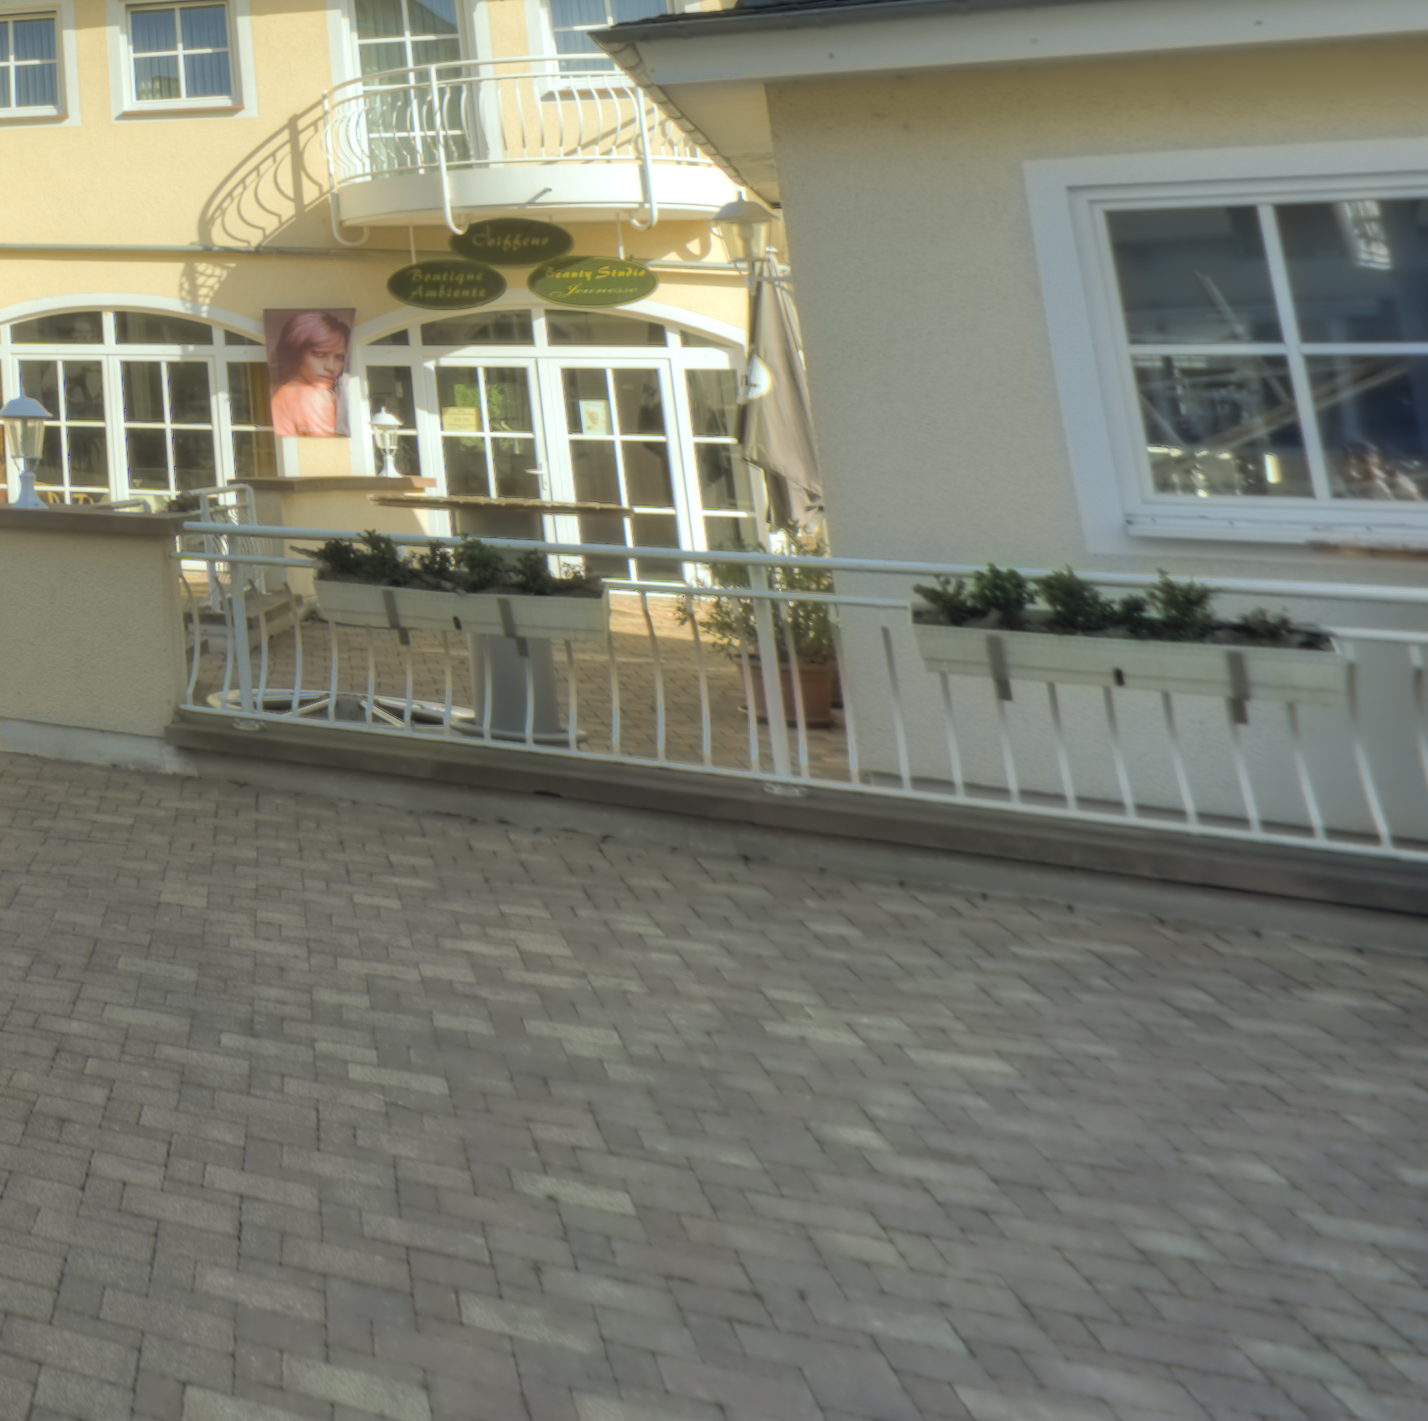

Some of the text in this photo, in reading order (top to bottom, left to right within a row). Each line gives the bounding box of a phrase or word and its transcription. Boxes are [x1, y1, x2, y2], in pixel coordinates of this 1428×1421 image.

[472, 233, 550, 251] Coiffeur
[408, 268, 484, 285] Boutique
[546, 265, 646, 281] Beauty Studio
[409, 284, 486, 300] Ambiente
